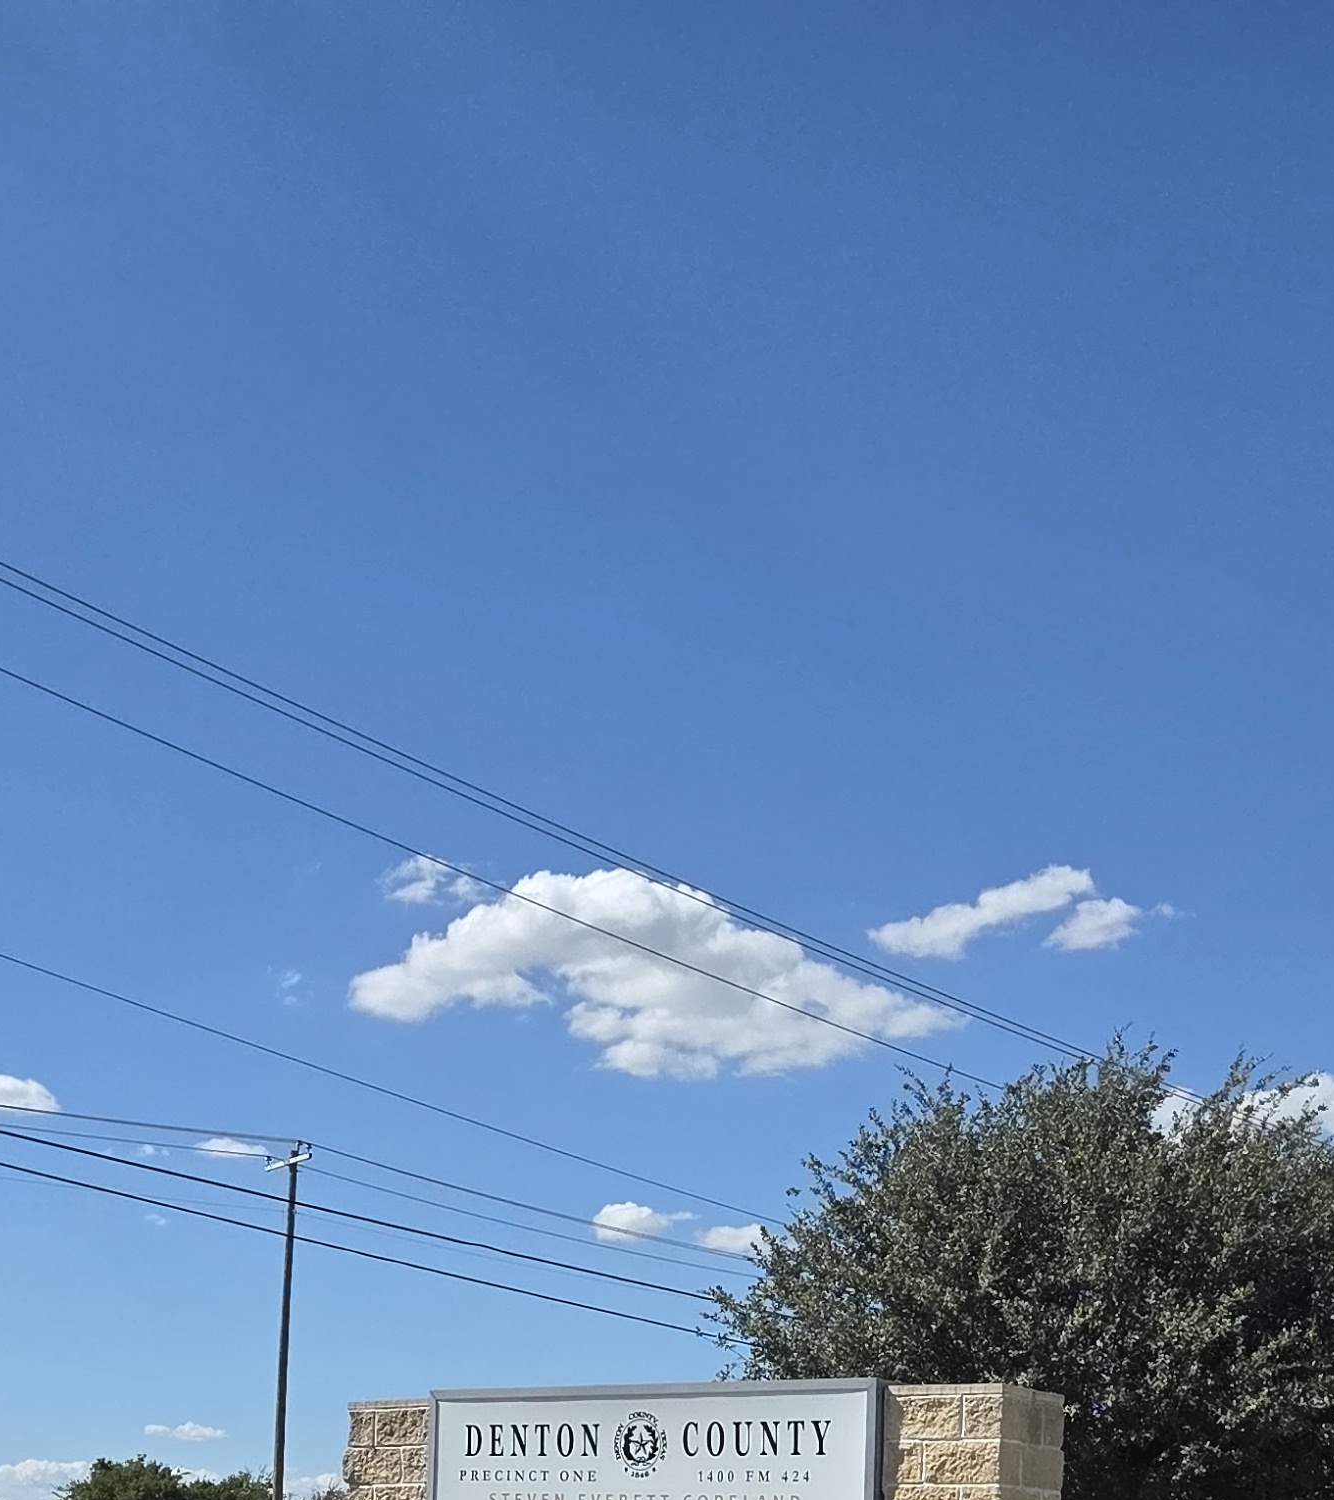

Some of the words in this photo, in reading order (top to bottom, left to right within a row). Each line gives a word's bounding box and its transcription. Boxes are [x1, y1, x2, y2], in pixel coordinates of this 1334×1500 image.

[464, 1423, 600, 1457] DENTON
[682, 1420, 832, 1457] COUNTY
[660, 1429, 668, 1461] TEXAS
[459, 1470, 550, 1483] PRECINCT
[559, 1470, 598, 1483] ONE
[697, 1470, 735, 1482] 1400
[745, 1471, 771, 1482] FM
[781, 1470, 811, 1483] 424
